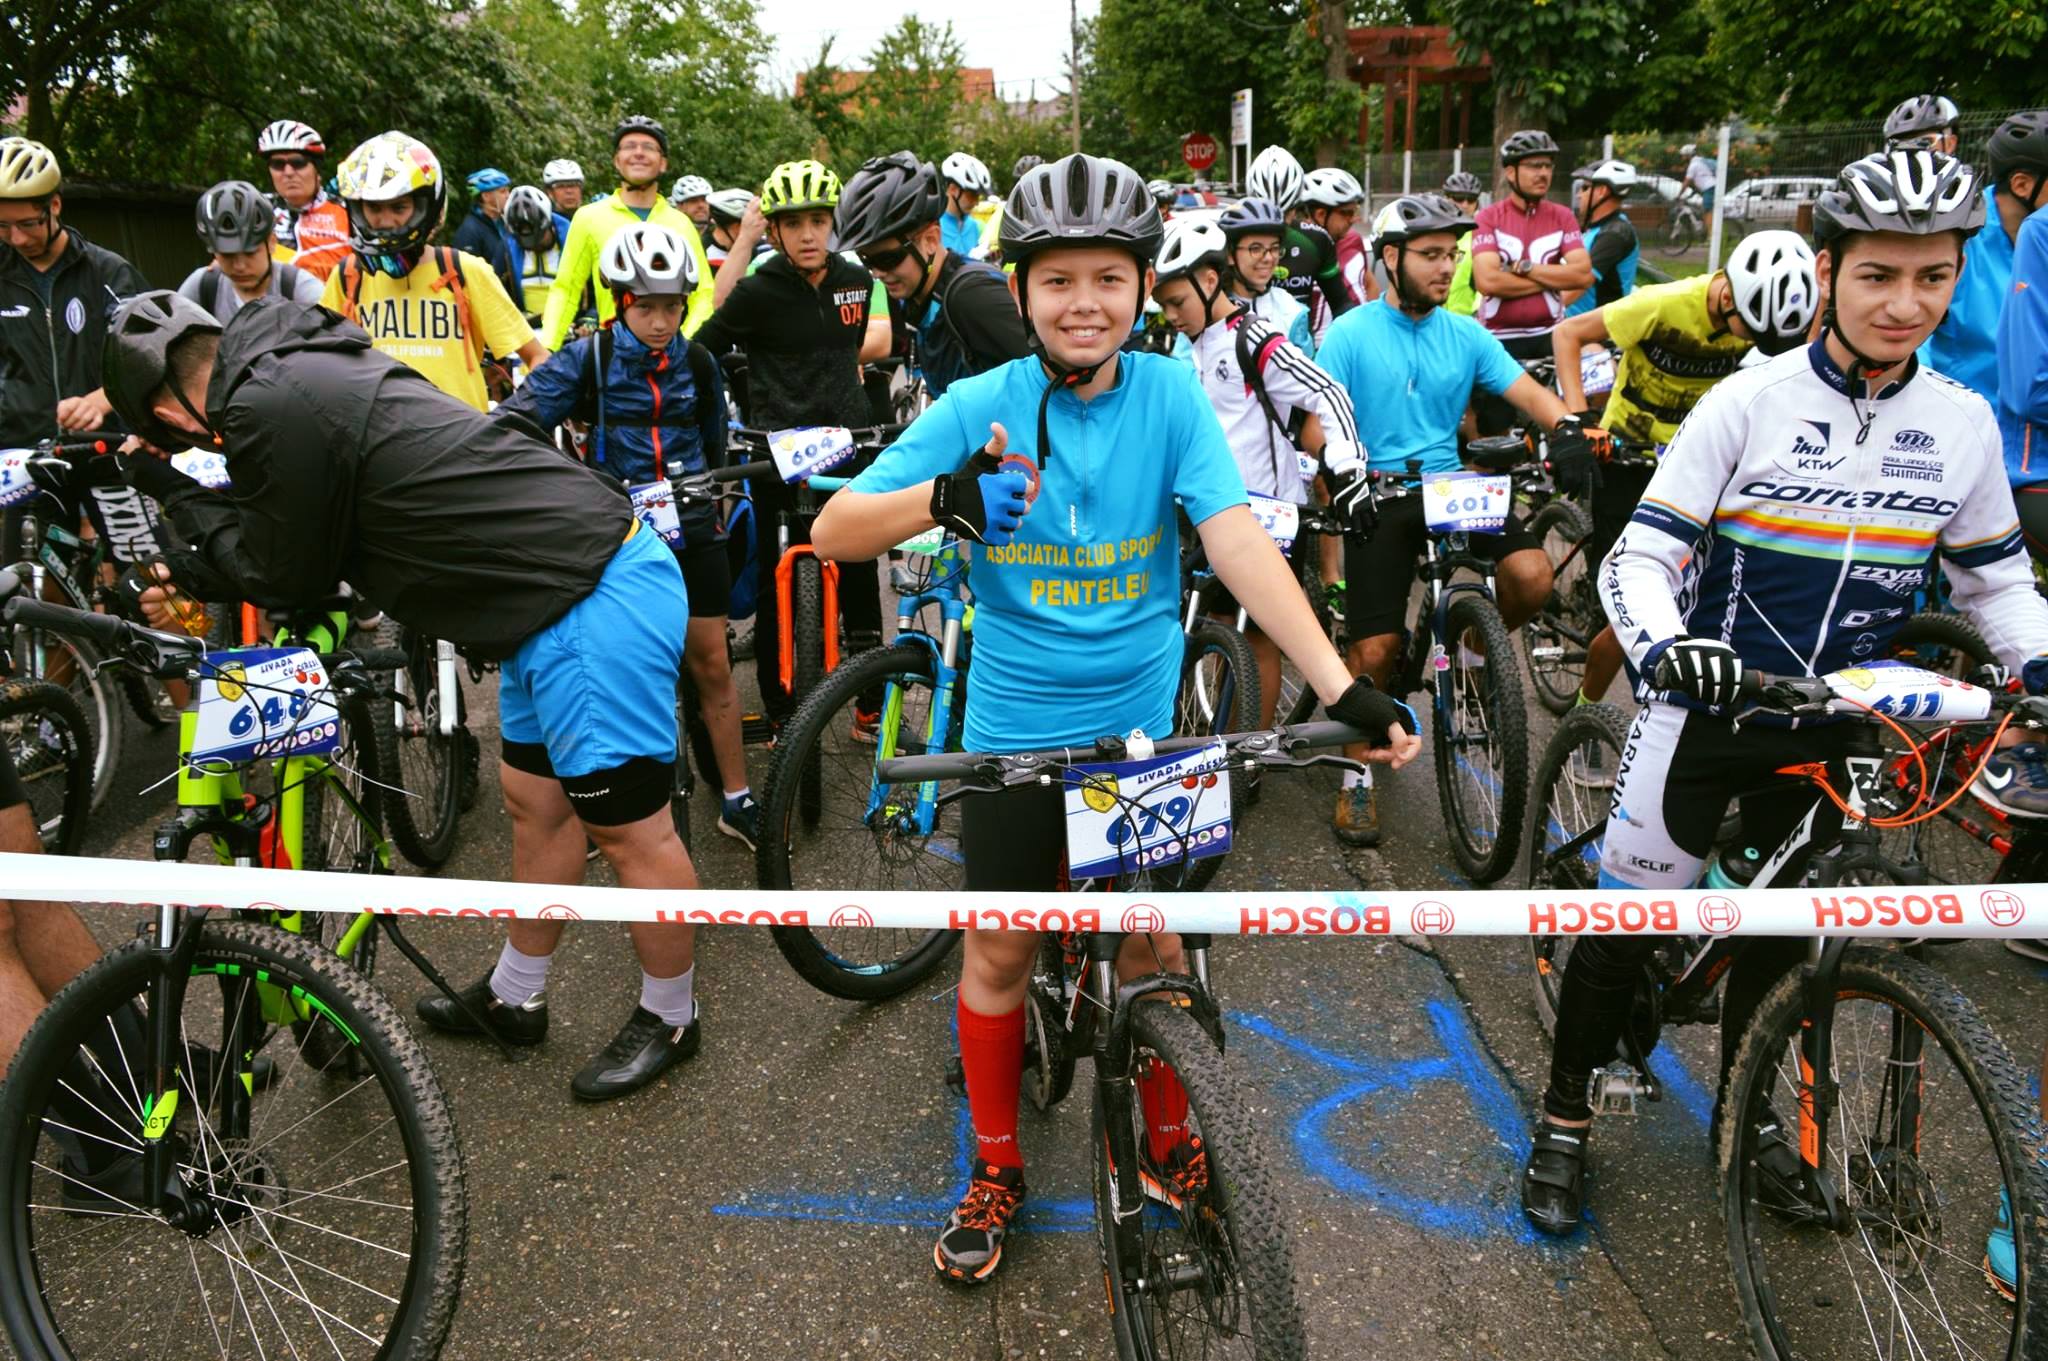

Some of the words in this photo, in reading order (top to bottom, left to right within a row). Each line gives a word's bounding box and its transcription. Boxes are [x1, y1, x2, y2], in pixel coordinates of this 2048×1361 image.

[1186, 143, 1214, 160] STOP
[359, 299, 465, 339] MALIBU
[792, 435, 834, 467] 604
[1881, 468, 1943, 483] SHIMANO
[1446, 495, 1488, 515] 601
[1739, 481, 1959, 517] corratec
[986, 542, 1070, 566] ASOCIATIA
[1075, 543, 1116, 567] CLUB
[261, 658, 294, 674] LIVADA
[229, 688, 310, 738] 648
[1137, 763, 1183, 785] LIVADA
[1609, 703, 1651, 820] GARMIN
[1106, 795, 1193, 848] 679
[1638, 859, 1674, 873] CLIF
[949, 908, 1101, 932] BOSCH
[1239, 905, 1391, 935] BOSCH
[1528, 901, 1679, 934] BOSCH
[1811, 893, 1964, 928] BOSCH
